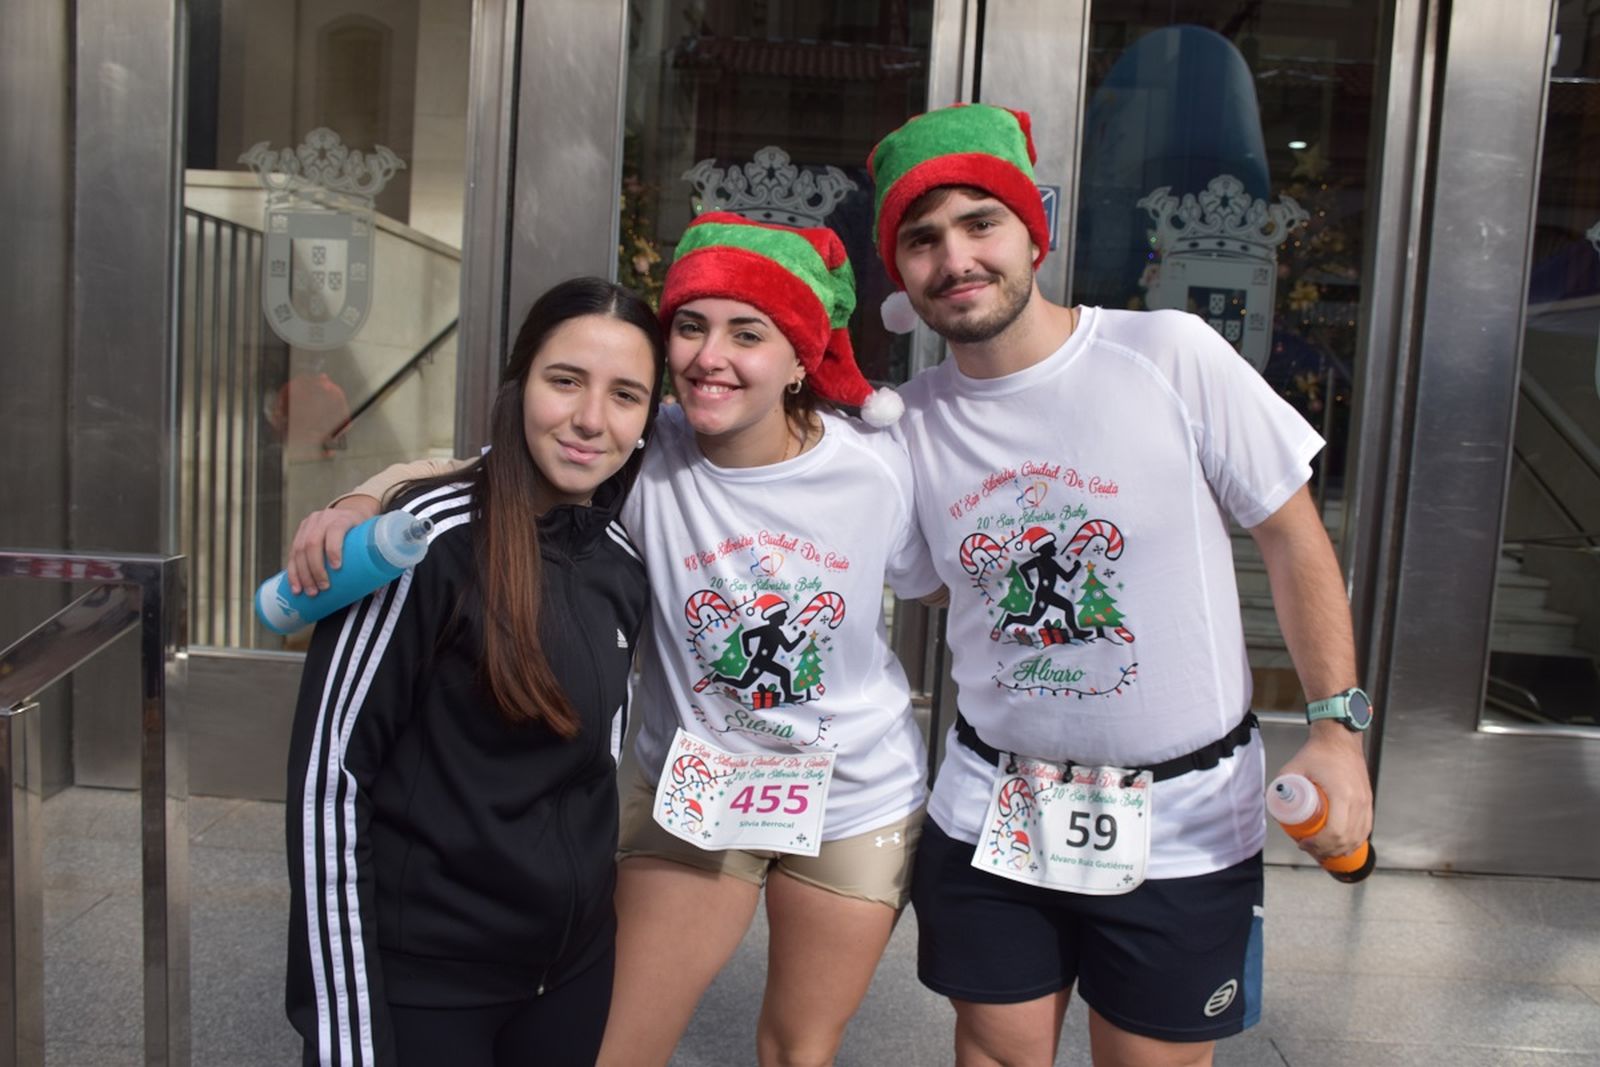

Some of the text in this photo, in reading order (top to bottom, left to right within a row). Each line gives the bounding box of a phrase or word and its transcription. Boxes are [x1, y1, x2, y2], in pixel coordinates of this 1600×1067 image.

[964, 494, 980, 511] San
[981, 468, 1017, 497] Silvestre
[1021, 460, 1061, 479] Ciudad
[1063, 468, 1085, 488] De
[1088, 476, 1119, 495] Ceuta
[996, 513, 1015, 527] San
[1018, 508, 1056, 525] Silvestre
[1060, 503, 1088, 521] Baby
[700, 551, 717, 567] San
[717, 536, 754, 556] Silvestre
[758, 530, 801, 552] Ciudad
[801, 542, 821, 562] De
[824, 552, 850, 570] Ceuta
[729, 577, 748, 592] San
[750, 577, 791, 592] Silvestre
[794, 575, 822, 592] Baby
[1012, 655, 1086, 684] Álvaro
[724, 709, 796, 739] Silvia
[729, 784, 810, 815] 455
[738, 820, 795, 829] Silvia Berrocal
[1065, 810, 1119, 852] 59
